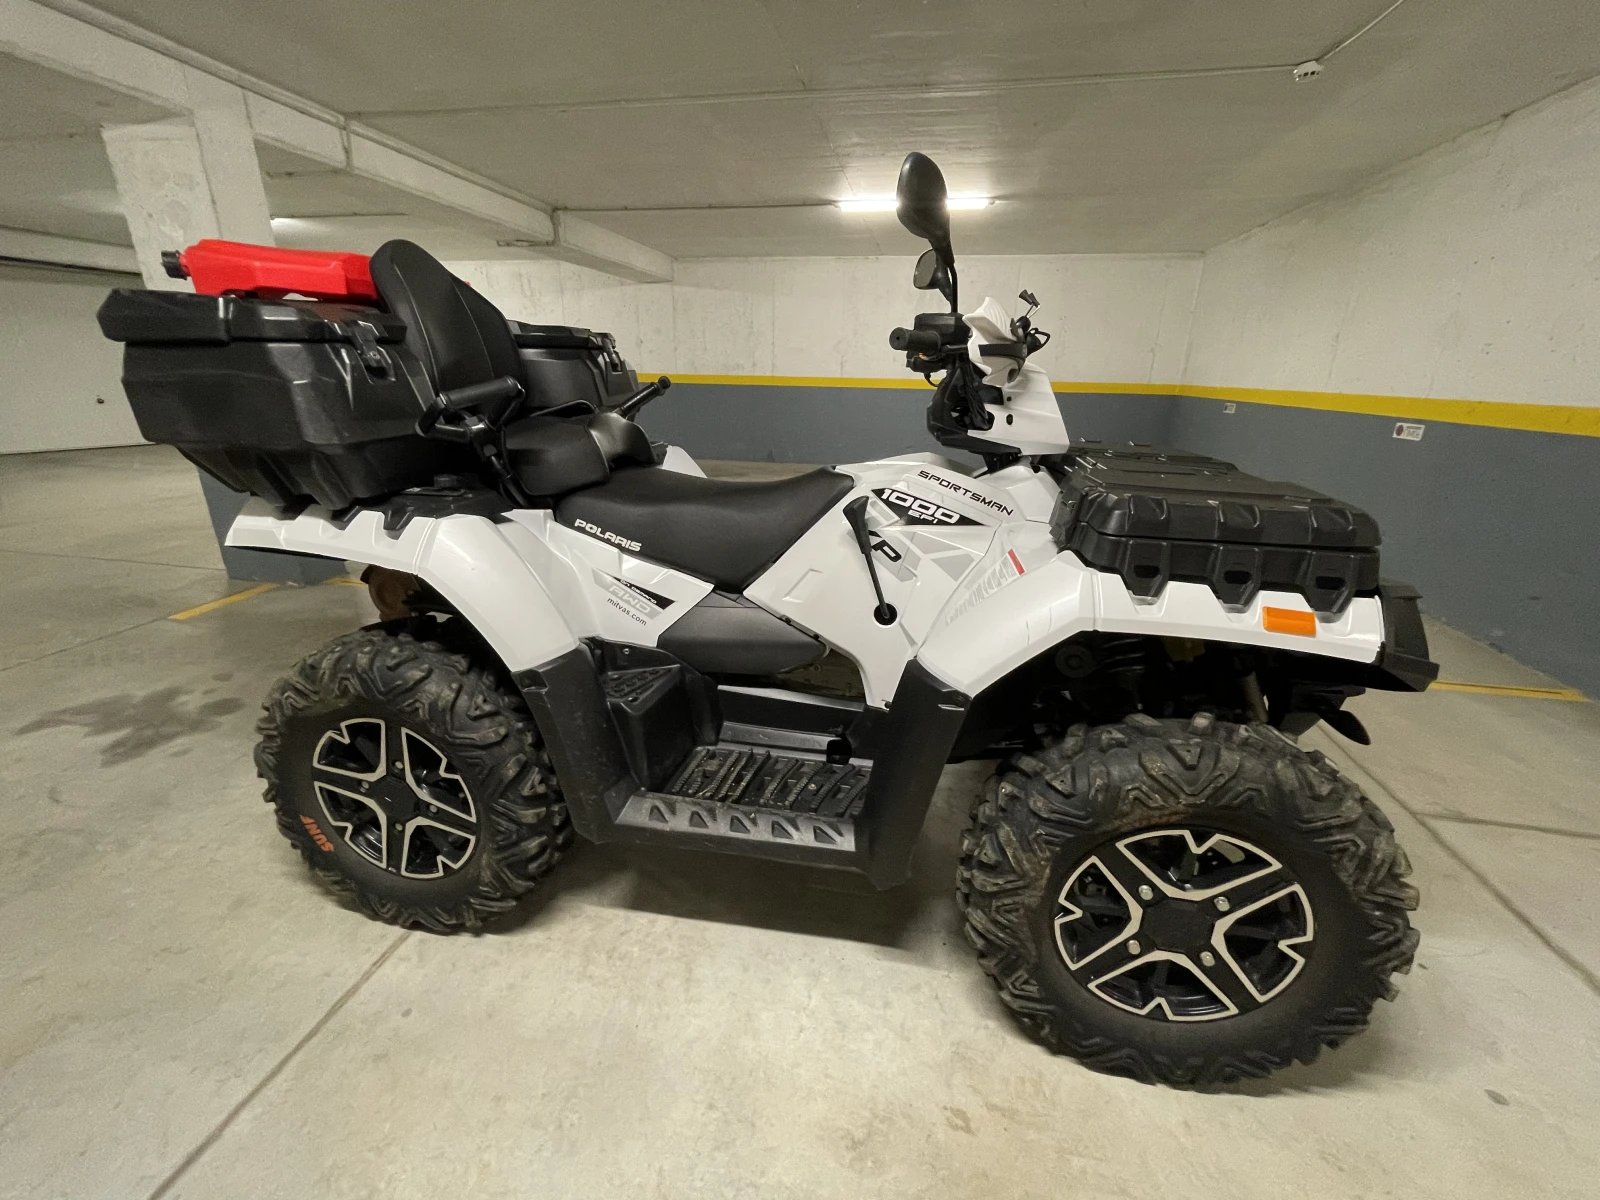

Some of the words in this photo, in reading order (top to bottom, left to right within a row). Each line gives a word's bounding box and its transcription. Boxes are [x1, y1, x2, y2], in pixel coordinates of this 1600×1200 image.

[880, 488, 960, 524] 1000
[918, 470, 1014, 516] SPORTSMAN
[908, 510, 939, 524] EFI
[574, 518, 642, 551] POLARIS
[606, 597, 647, 626] mitvas.com
[608, 584, 651, 613] AWD
